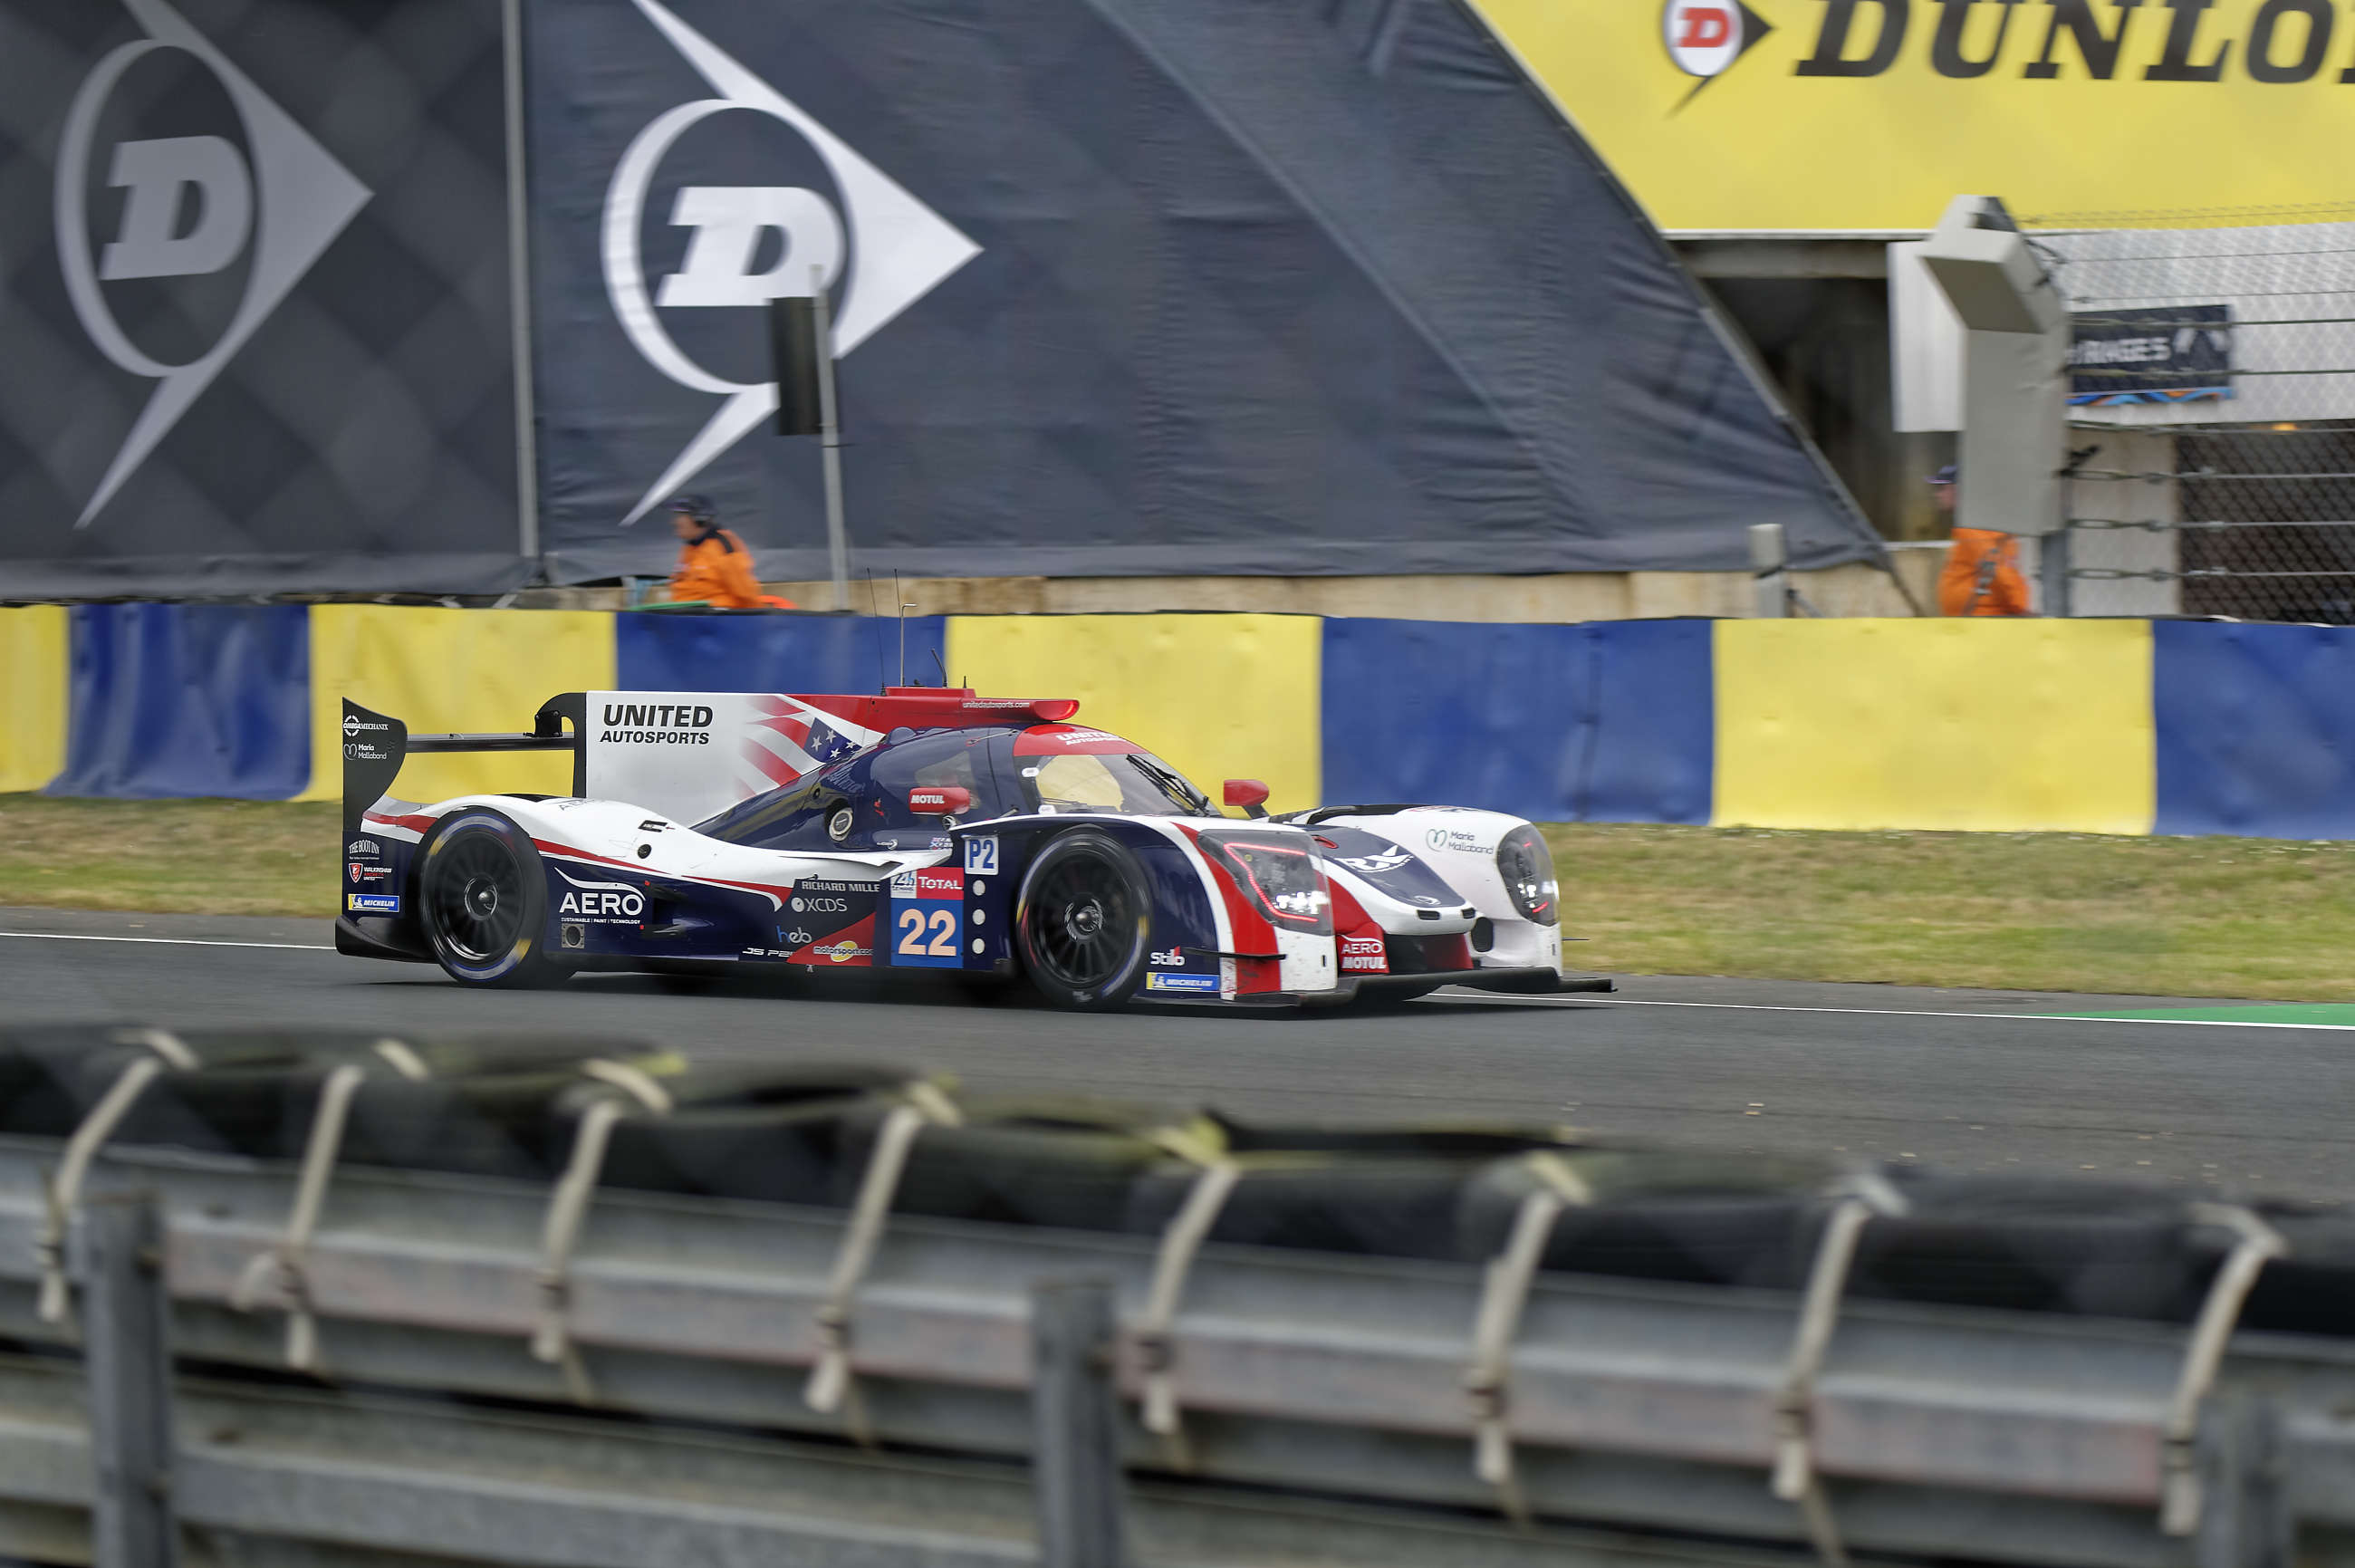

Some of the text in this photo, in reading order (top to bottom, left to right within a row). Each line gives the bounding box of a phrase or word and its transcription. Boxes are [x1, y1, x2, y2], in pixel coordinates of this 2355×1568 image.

[1790, 0, 2355, 84] DUNLO
[98, 135, 253, 281] D
[654, 186, 847, 308] D
[603, 704, 714, 727] UNITED
[600, 730, 710, 745] AUTOSPORTS
[910, 794, 946, 804] MOTUL
[968, 839, 995, 870] P2
[801, 881, 880, 892] RICHARD MILLE
[363, 899, 396, 908] MICHELIN
[559, 891, 644, 916] AERO
[776, 925, 812, 944] heb
[898, 908, 957, 957] 22
[742, 947, 764, 957] JS
[1341, 943, 1383, 955] AERO
[1343, 957, 1386, 969] MOTUL
